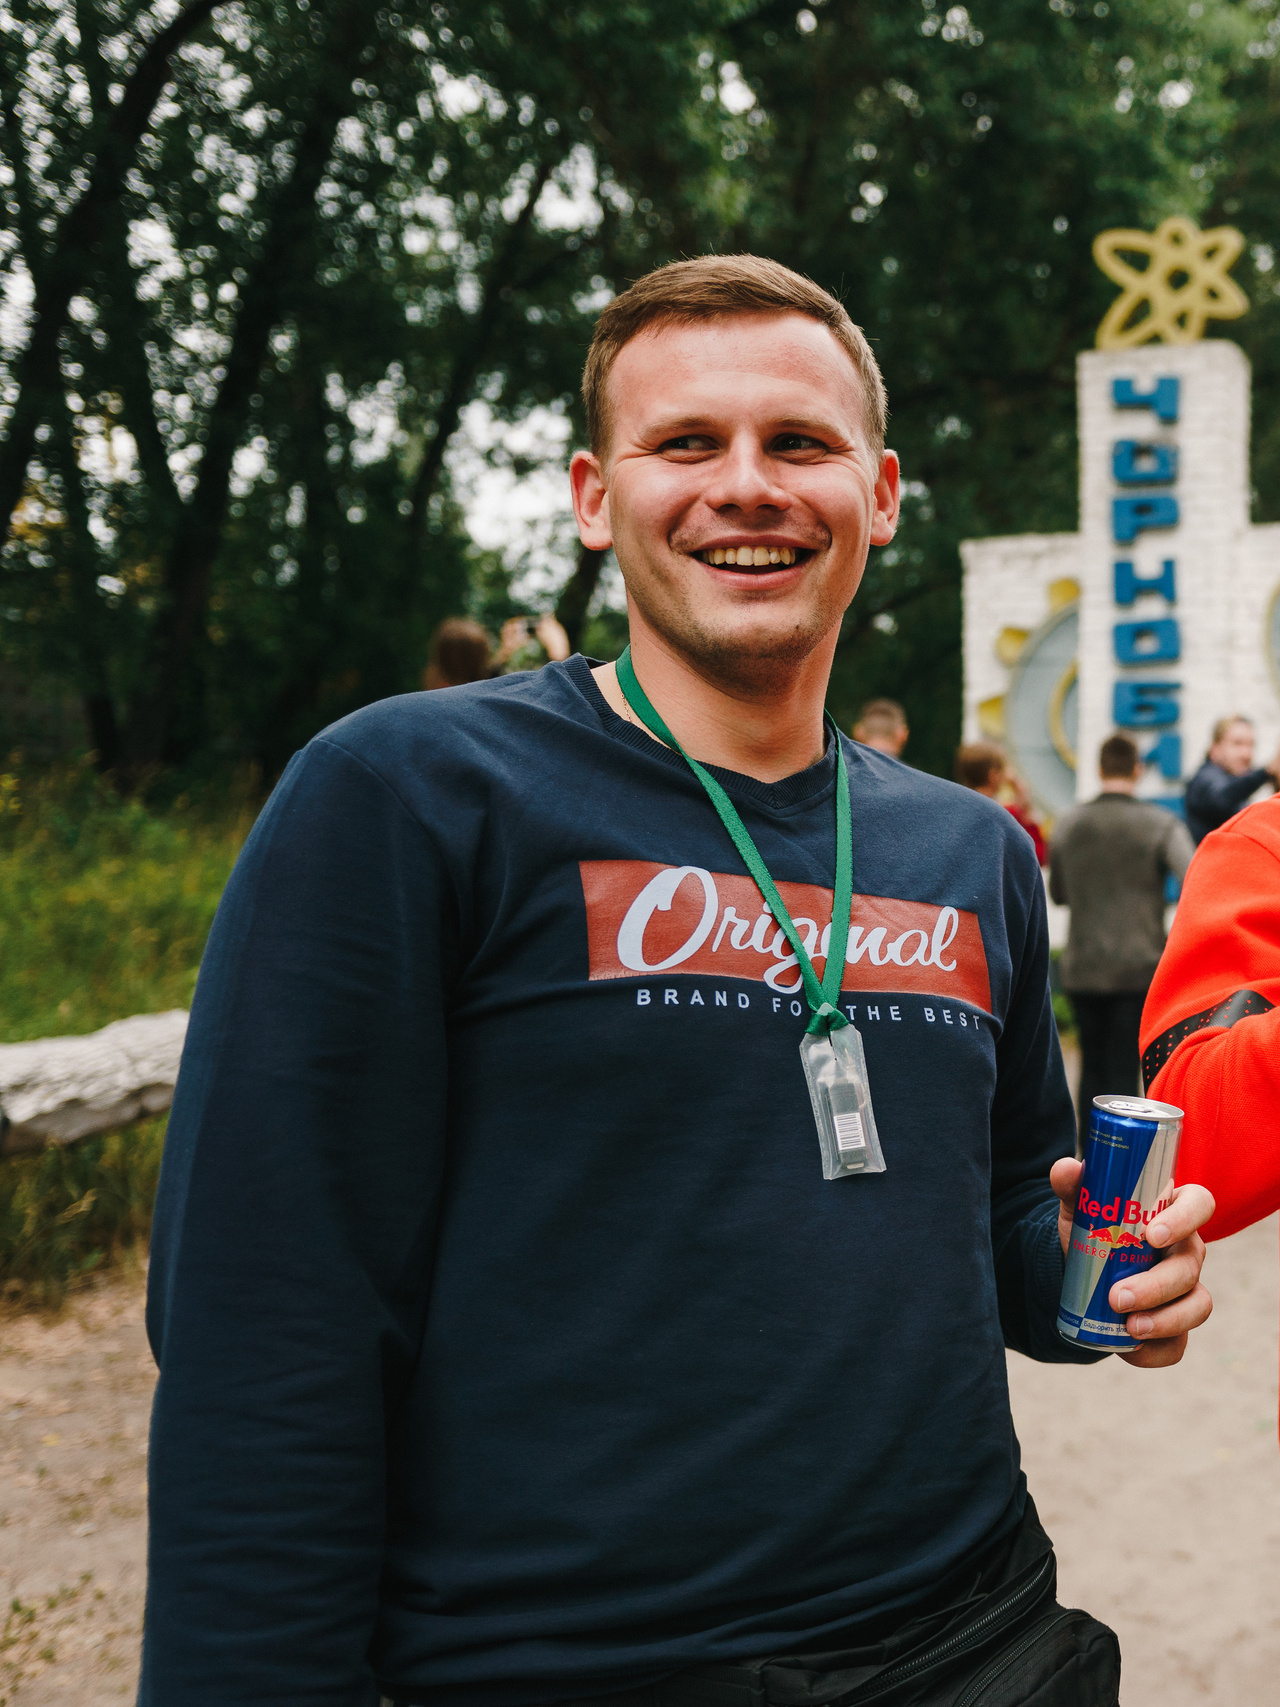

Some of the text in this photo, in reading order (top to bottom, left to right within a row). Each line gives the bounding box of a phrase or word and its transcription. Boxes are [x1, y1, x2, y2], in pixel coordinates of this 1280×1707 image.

[1112, 376, 1184, 830] ЧОРНОБИ
[636, 988, 980, 1030] BRAND FO THE BEST
[1078, 1186, 1121, 1222] Red
[1073, 1239, 1154, 1264] ENERGY DRINK
